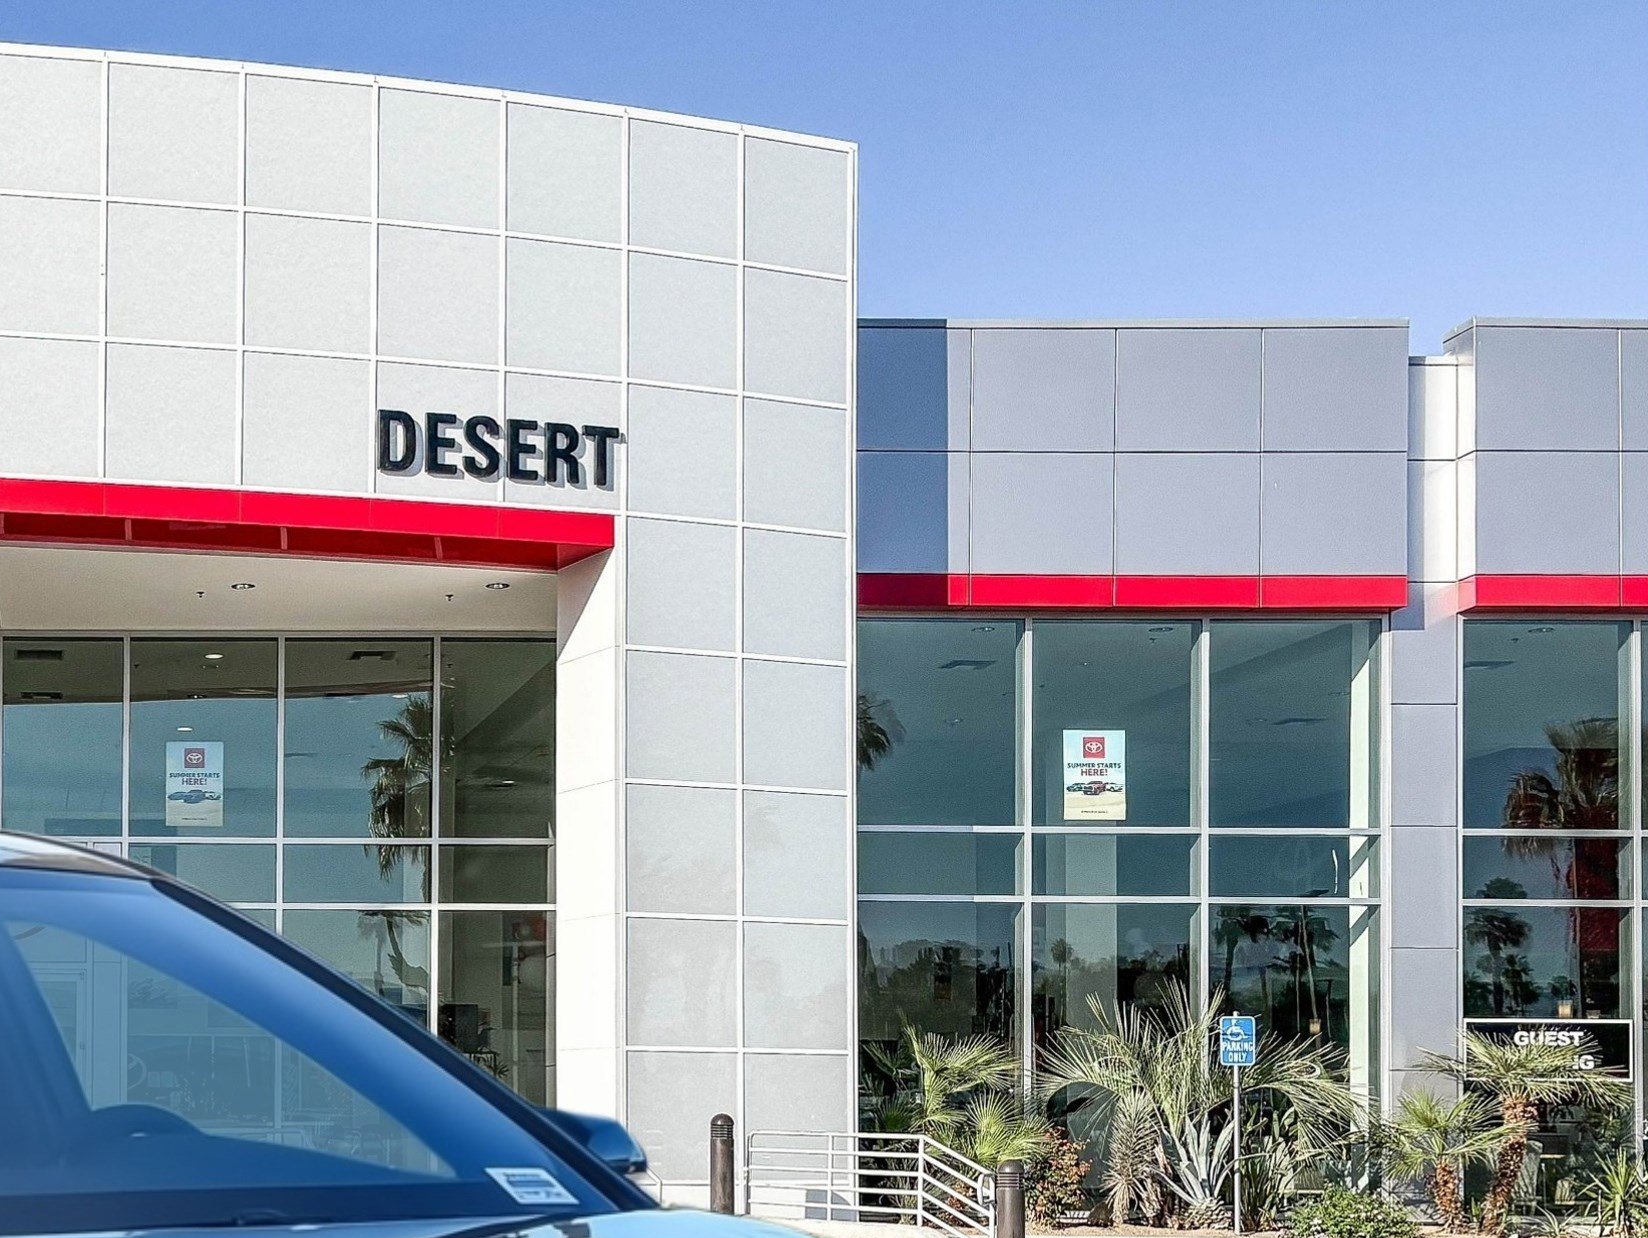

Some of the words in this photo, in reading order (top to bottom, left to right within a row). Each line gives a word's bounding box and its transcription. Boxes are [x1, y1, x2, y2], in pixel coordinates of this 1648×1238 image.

[377, 409, 620, 487] DESERT
[1513, 1030, 1584, 1047] GUEST
[1222, 1041, 1253, 1052] PARKING
[1228, 1052, 1247, 1062] ONLY
